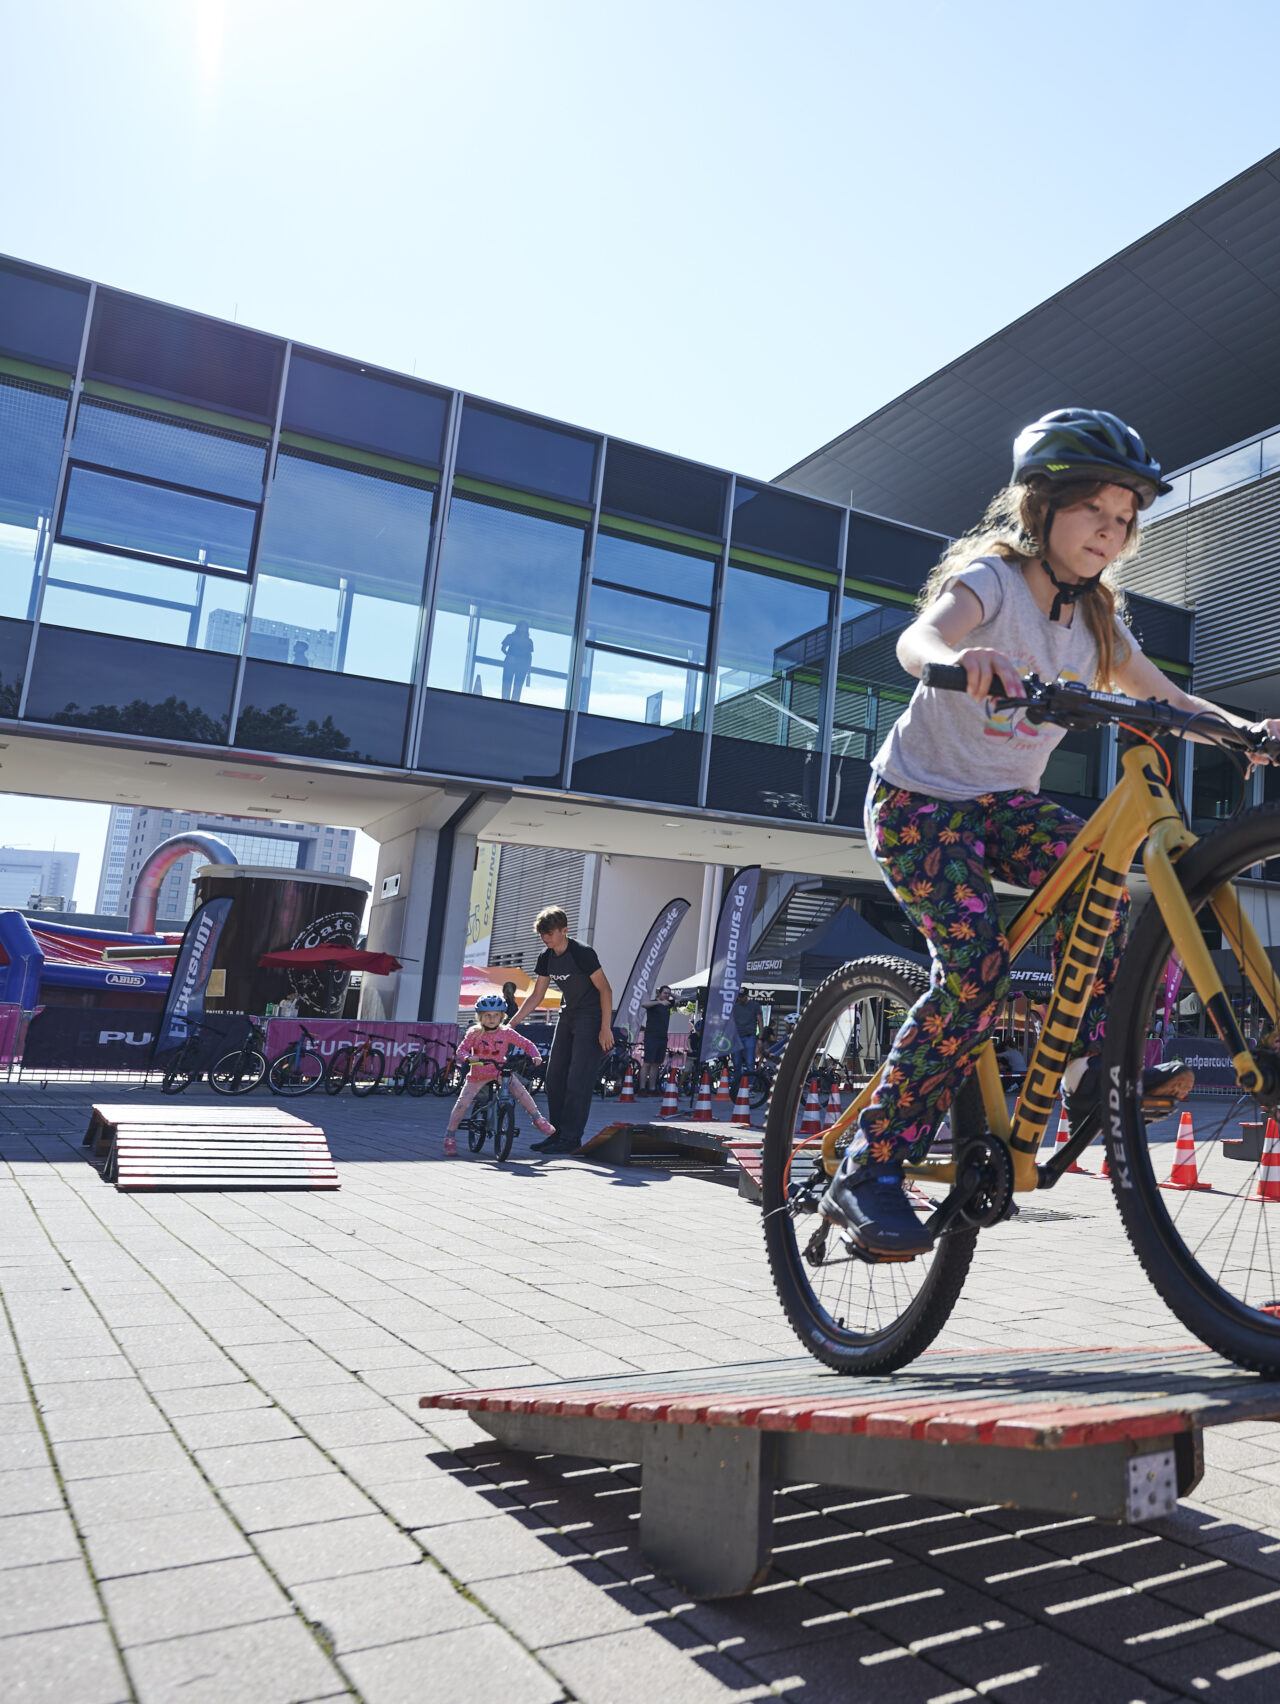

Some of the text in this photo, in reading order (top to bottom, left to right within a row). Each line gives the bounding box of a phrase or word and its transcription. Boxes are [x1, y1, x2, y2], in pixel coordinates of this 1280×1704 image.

[483, 844, 497, 926] CYCLING
[719, 885, 748, 1021] radparcours.de
[746, 960, 783, 971] EIGHTSHOT
[110, 975, 141, 985] ABUS
[841, 975, 895, 991] KENDA
[748, 989, 776, 998] UKY
[1010, 853, 1127, 1155] EIGHTSHOT
[98, 1031, 154, 1045] PU
[1184, 1055, 1234, 1071] radparcours
[1109, 1065, 1133, 1189] KENDA
